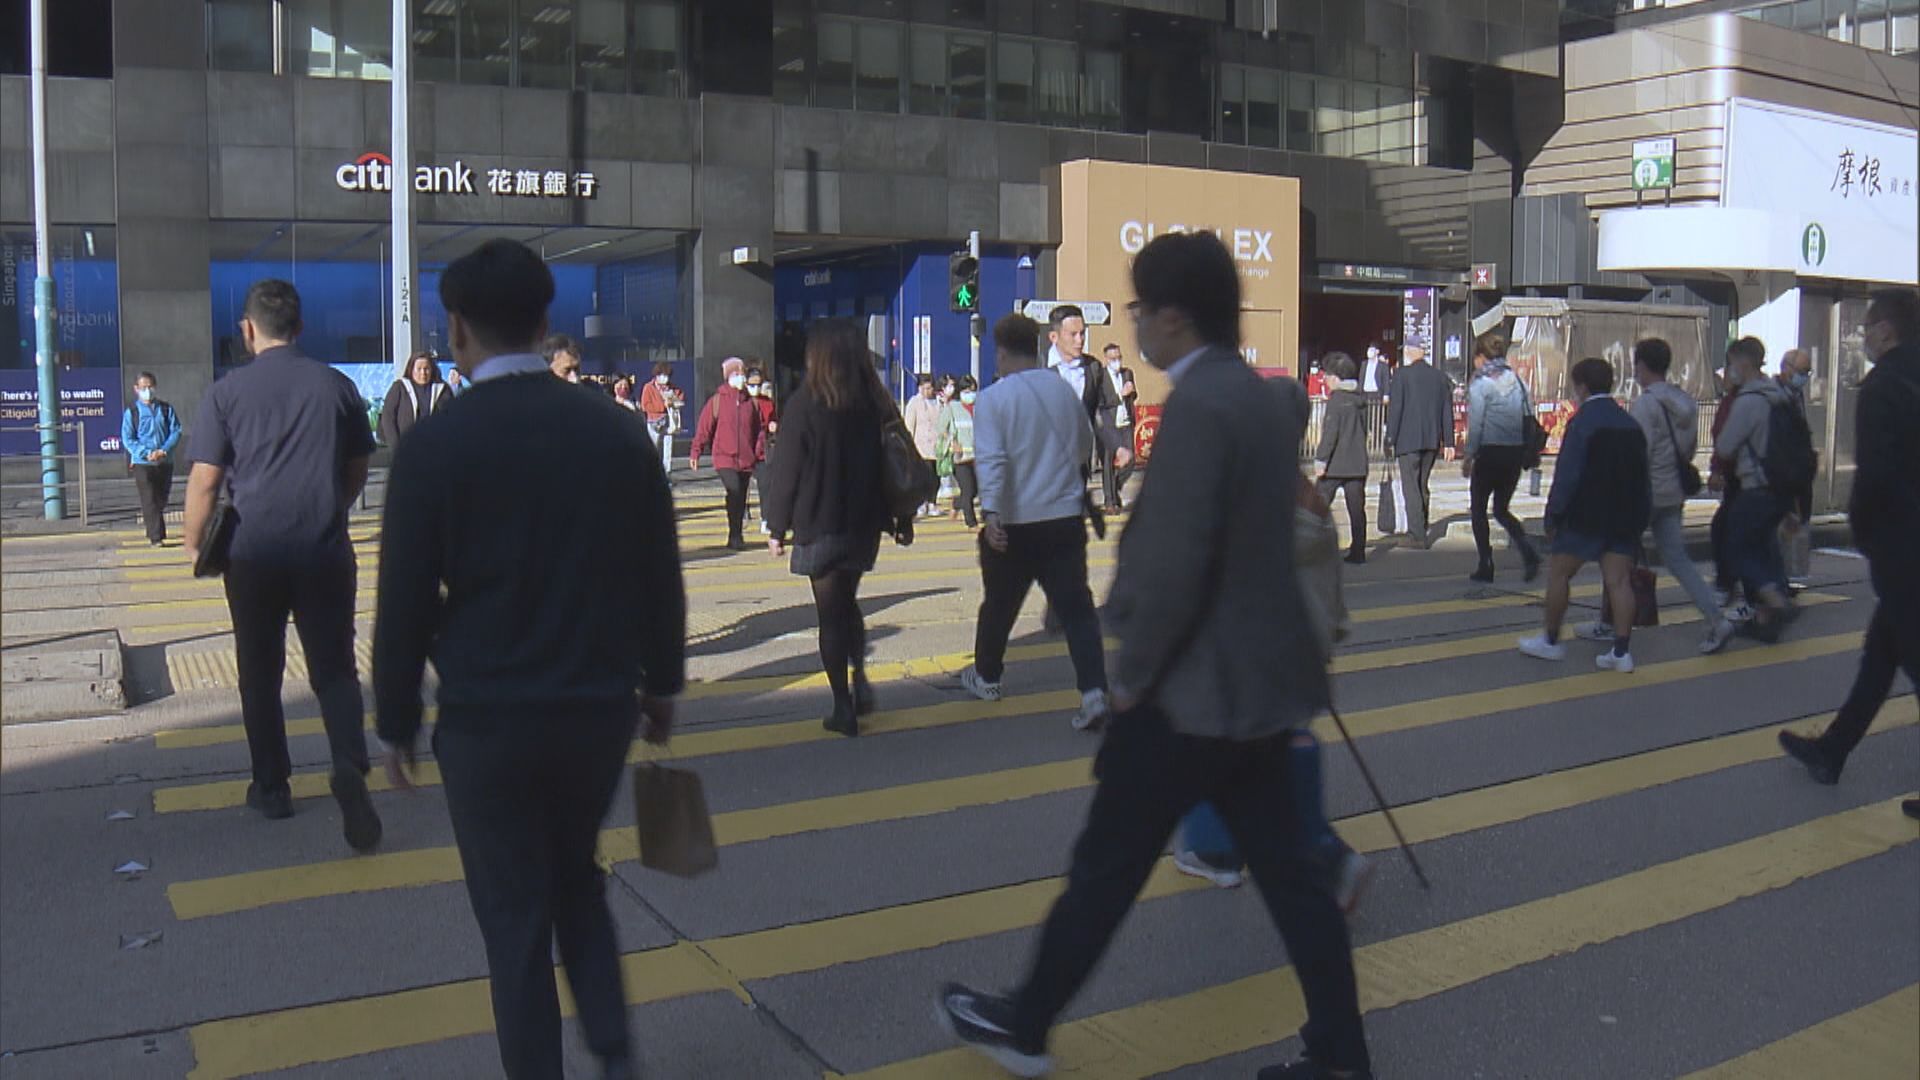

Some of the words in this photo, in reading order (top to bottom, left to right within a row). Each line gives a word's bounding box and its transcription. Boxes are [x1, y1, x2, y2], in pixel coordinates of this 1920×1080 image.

[336, 158, 473, 193] citiank
[487, 168, 597, 197] 花旗銀行
[60, 390, 71, 399] to
[73, 389, 104, 399] wealth
[76, 407, 104, 416] Client
[100, 438, 120, 450] citi
